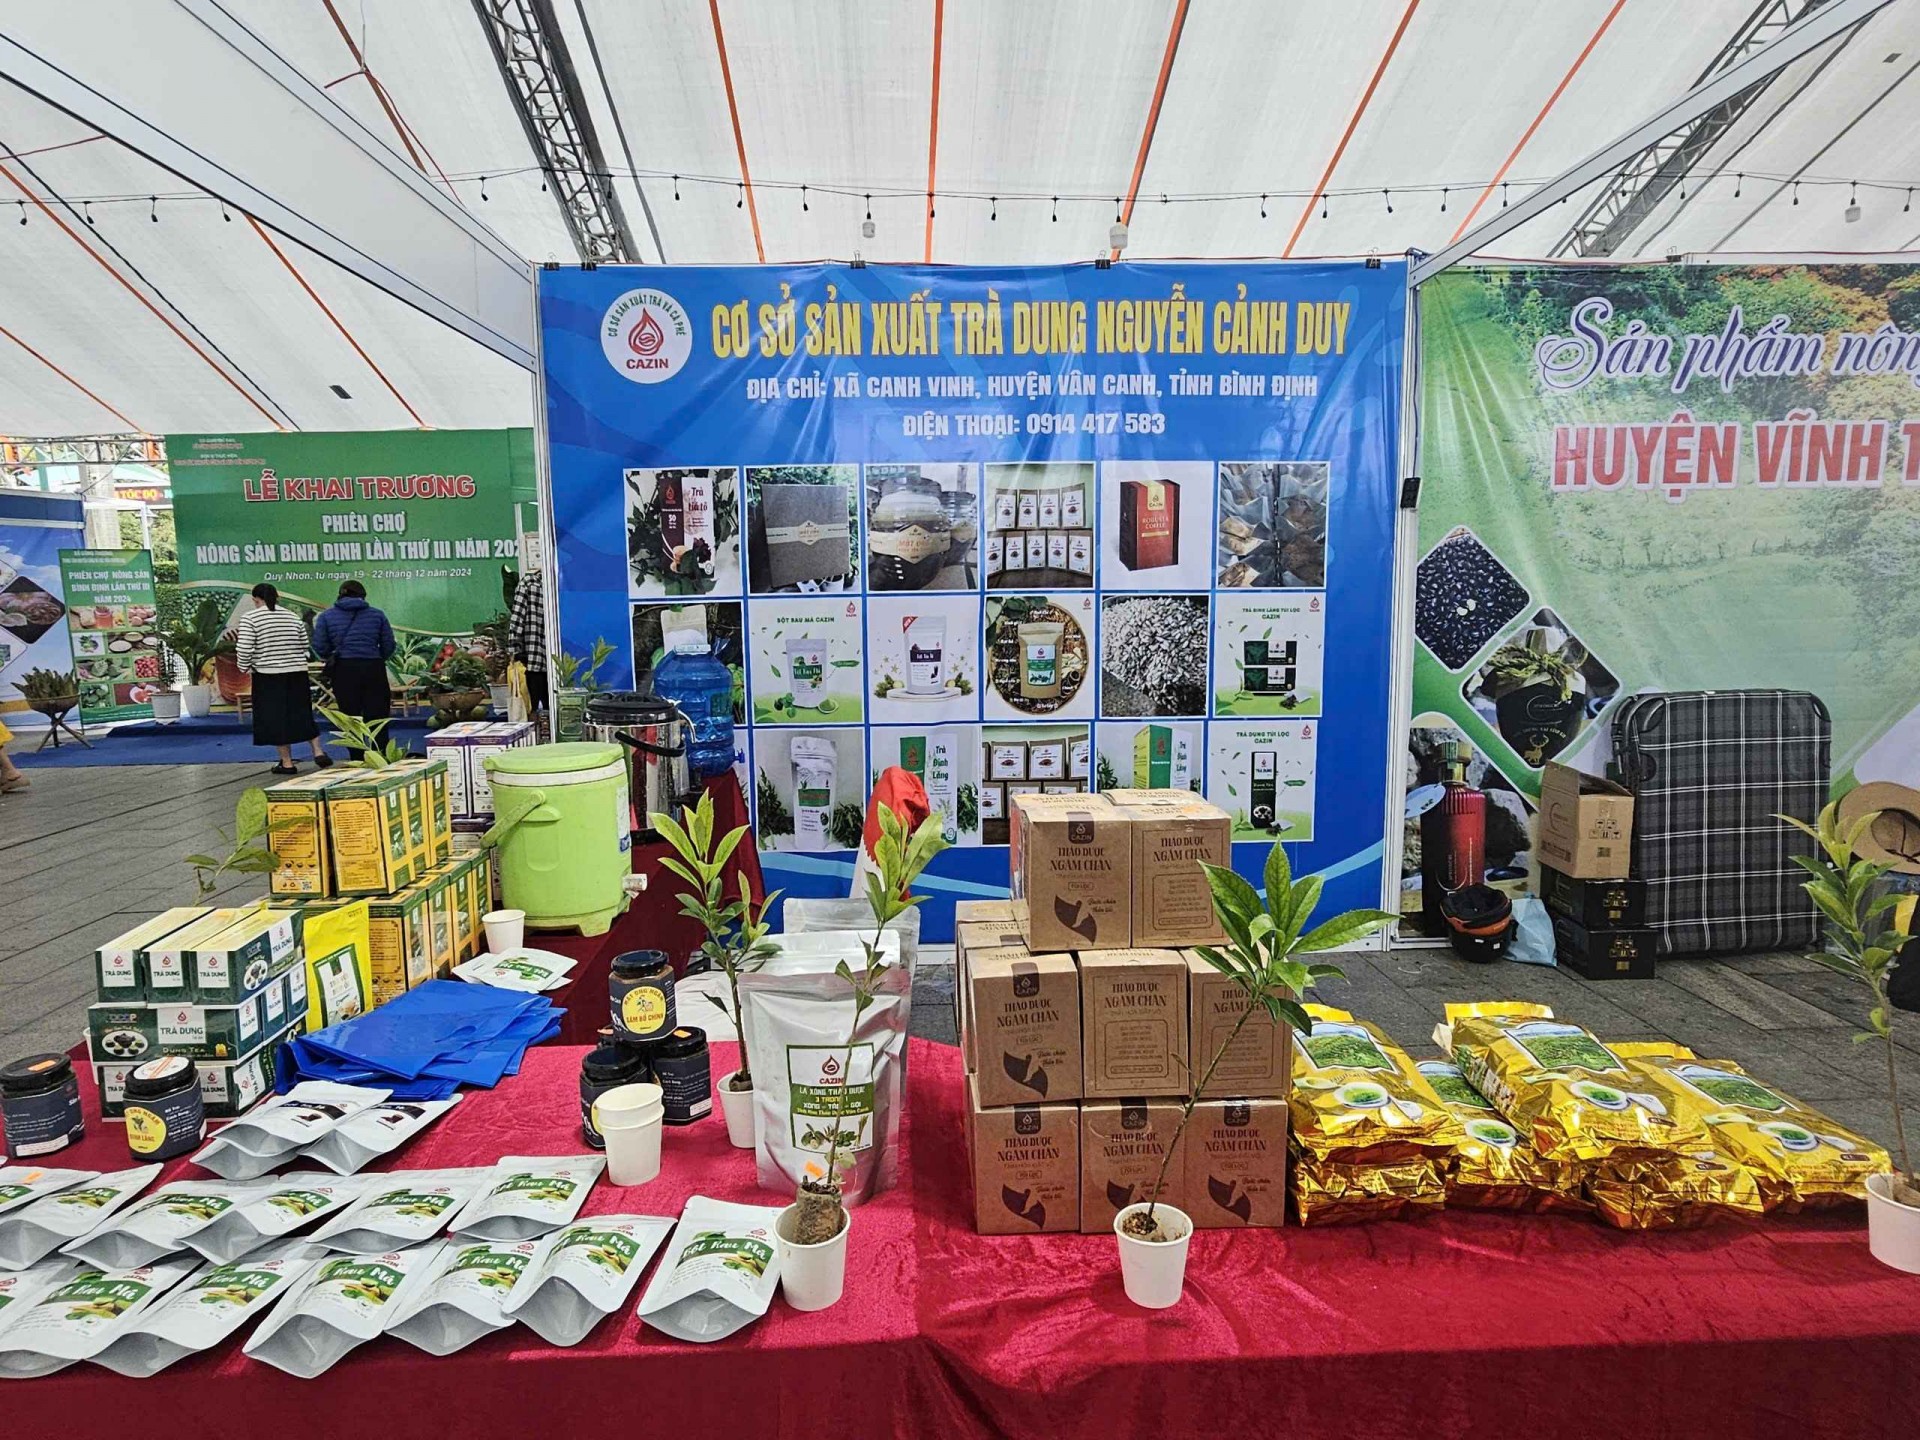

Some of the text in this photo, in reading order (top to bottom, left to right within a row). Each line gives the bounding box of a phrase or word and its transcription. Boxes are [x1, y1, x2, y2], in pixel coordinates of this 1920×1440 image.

[712, 283, 1350, 358] CƠ SỞ SẢN XUẤT TRÀ DUNG NGUYỄN CẢNH DUY
[1539, 298, 1920, 391] Sản phẩm nôn
[626, 358, 669, 369] CAZIN
[746, 368, 1317, 404] ĐỊA CHỈ: XÃ CANH VINH, HUYỆN VÂN CANH, TỈNH BÌNH ĐỊNH
[903, 411, 1165, 441] ĐIỆN THOẠI: 0914 417 583
[1554, 412, 1885, 498] HUYỆN VĨNH
[243, 469, 475, 501] LỄ KHAI TRƯƠNG
[322, 511, 406, 533] PHIÊN CHỢ
[197, 536, 489, 566] NÔNG SẢN BÌNH ĐỊNH LẦN THỨ III NĂM
[264, 572, 282, 582] Quy
[354, 570, 364, 579] 19
[372, 570, 382, 578] 22
[385, 569, 411, 580] tháng
[415, 569, 425, 578] 12
[427, 568, 447, 577] năm
[450, 568, 472, 577] 2024
[160, 1026, 203, 1035] TRÀ DUNG
[370, 1267, 395, 1285] Má
